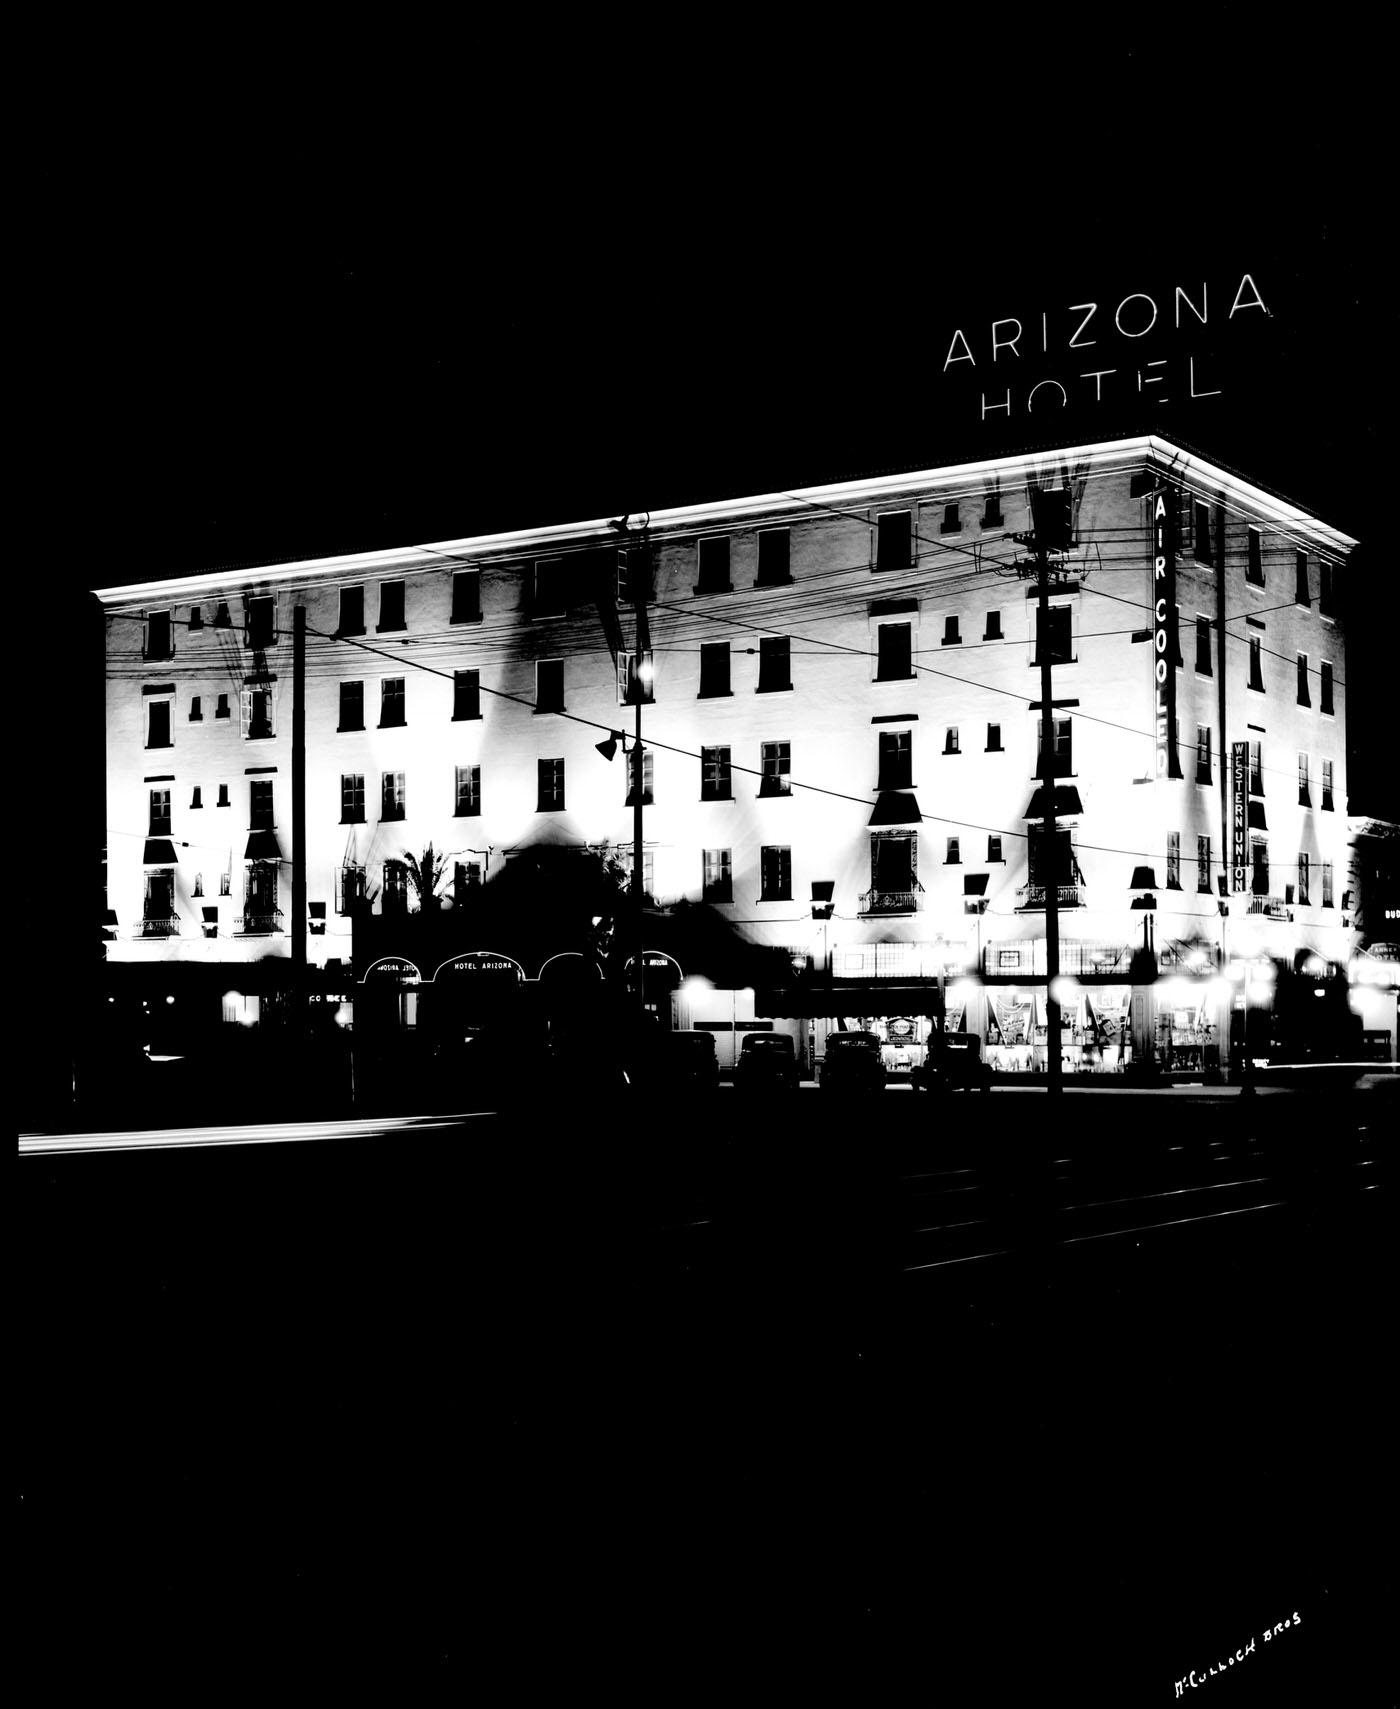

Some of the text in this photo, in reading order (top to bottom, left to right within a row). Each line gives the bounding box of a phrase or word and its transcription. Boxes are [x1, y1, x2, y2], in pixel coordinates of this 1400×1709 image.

[943, 274, 1270, 373] ARIZONA
[980, 356, 1222, 420] HOTEL
[1155, 495, 1167, 774] AIR COOLED
[1234, 744, 1244, 892] WESTERN UNION
[482, 962, 512, 970] ARIZONA
